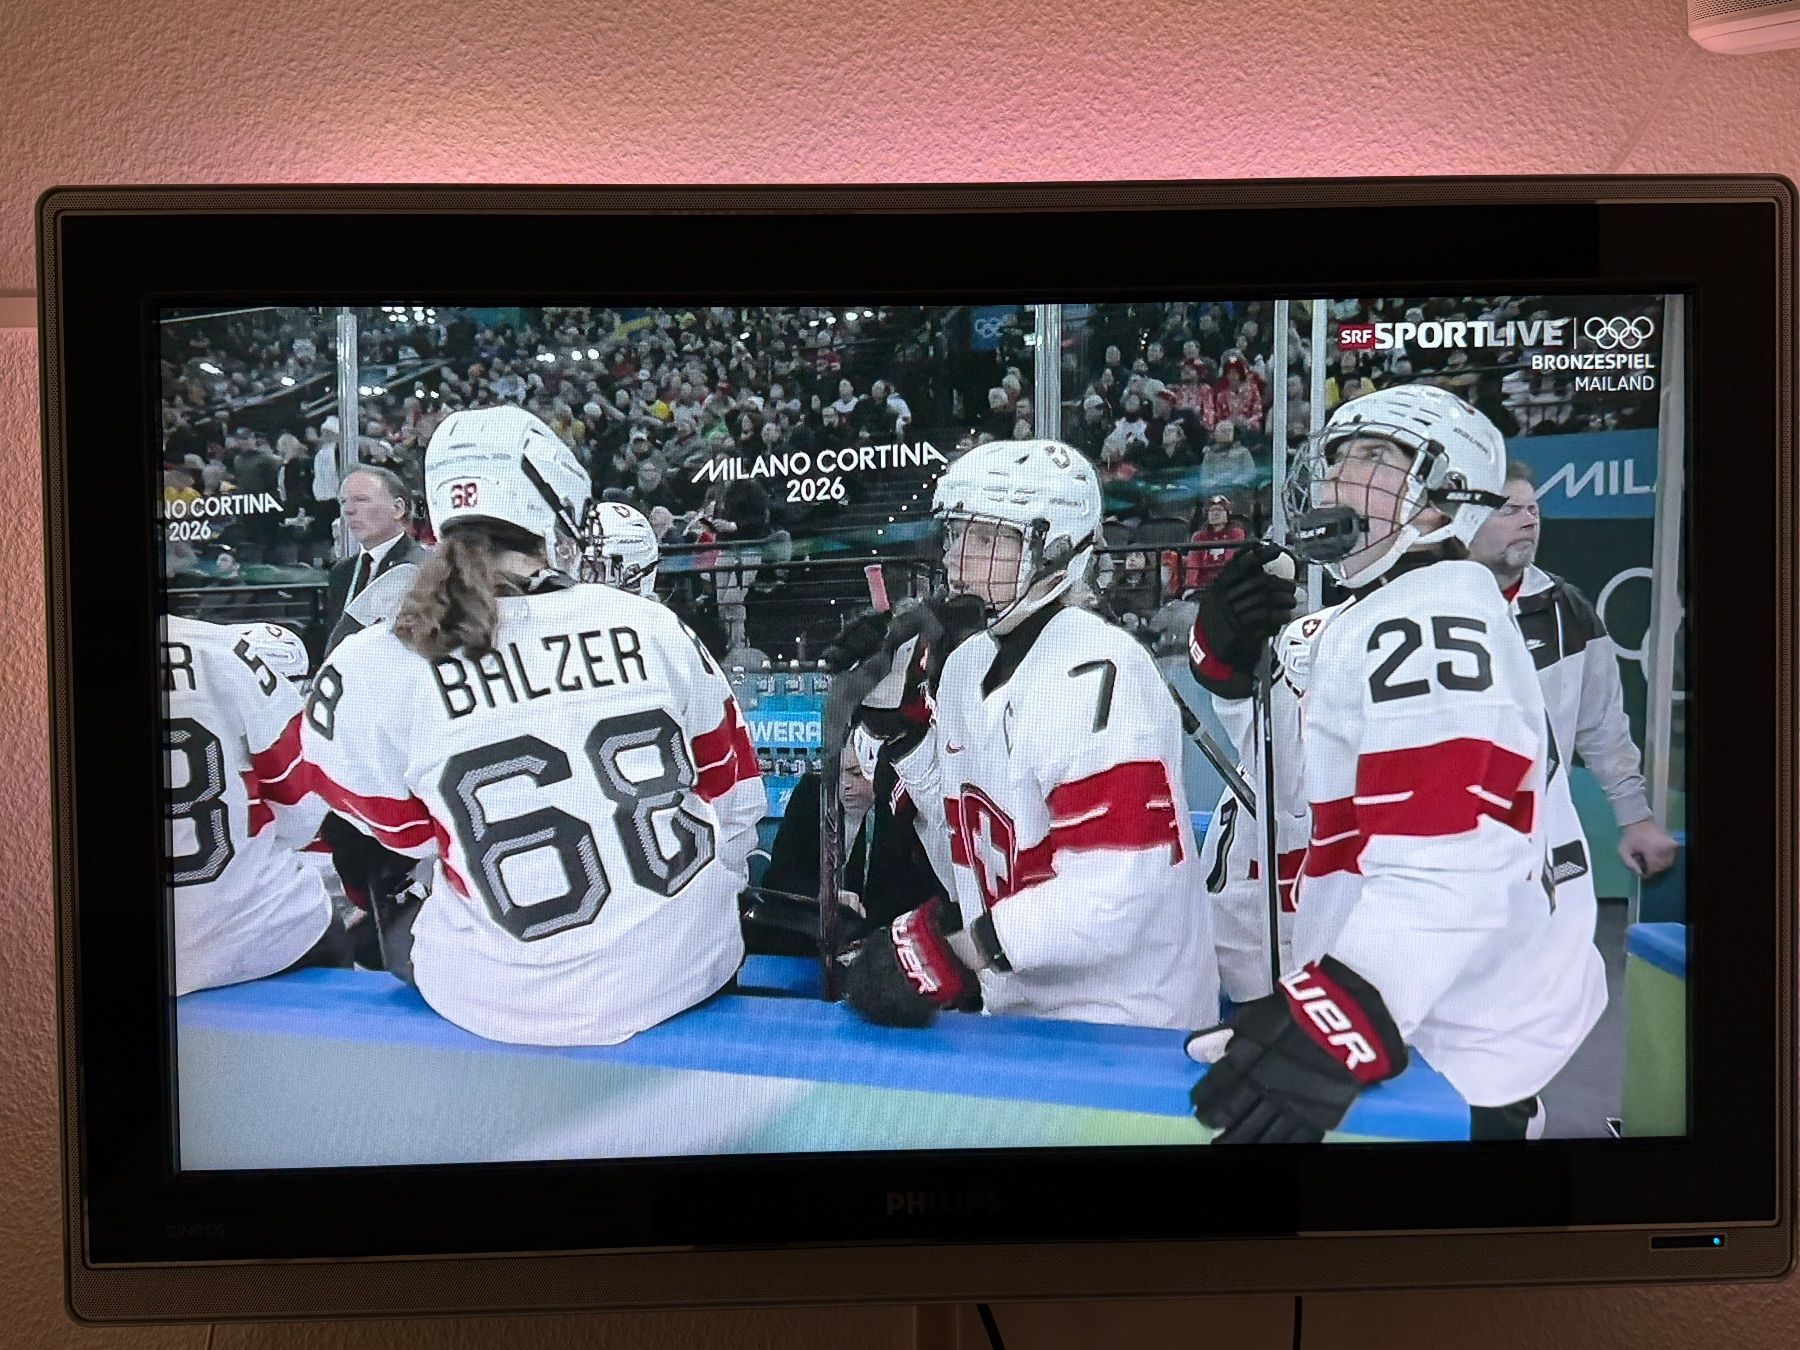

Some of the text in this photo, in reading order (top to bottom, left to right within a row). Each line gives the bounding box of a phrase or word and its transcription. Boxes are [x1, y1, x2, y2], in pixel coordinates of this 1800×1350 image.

[1341, 331, 1372, 344] SRF
[1532, 354, 1655, 370] BRONZESPIEL
[1575, 376, 1655, 392] MAILAND
[691, 441, 949, 483] MILANO CORTINA
[786, 476, 846, 502] 2026
[1535, 458, 1656, 501] MIL
[190, 492, 284, 517] CORTINA
[168, 519, 212, 541] 2026
[431, 626, 648, 719] BALZER
[1367, 616, 1492, 703] 25
[1067, 658, 1117, 734] 7
[438, 708, 716, 942] 68
